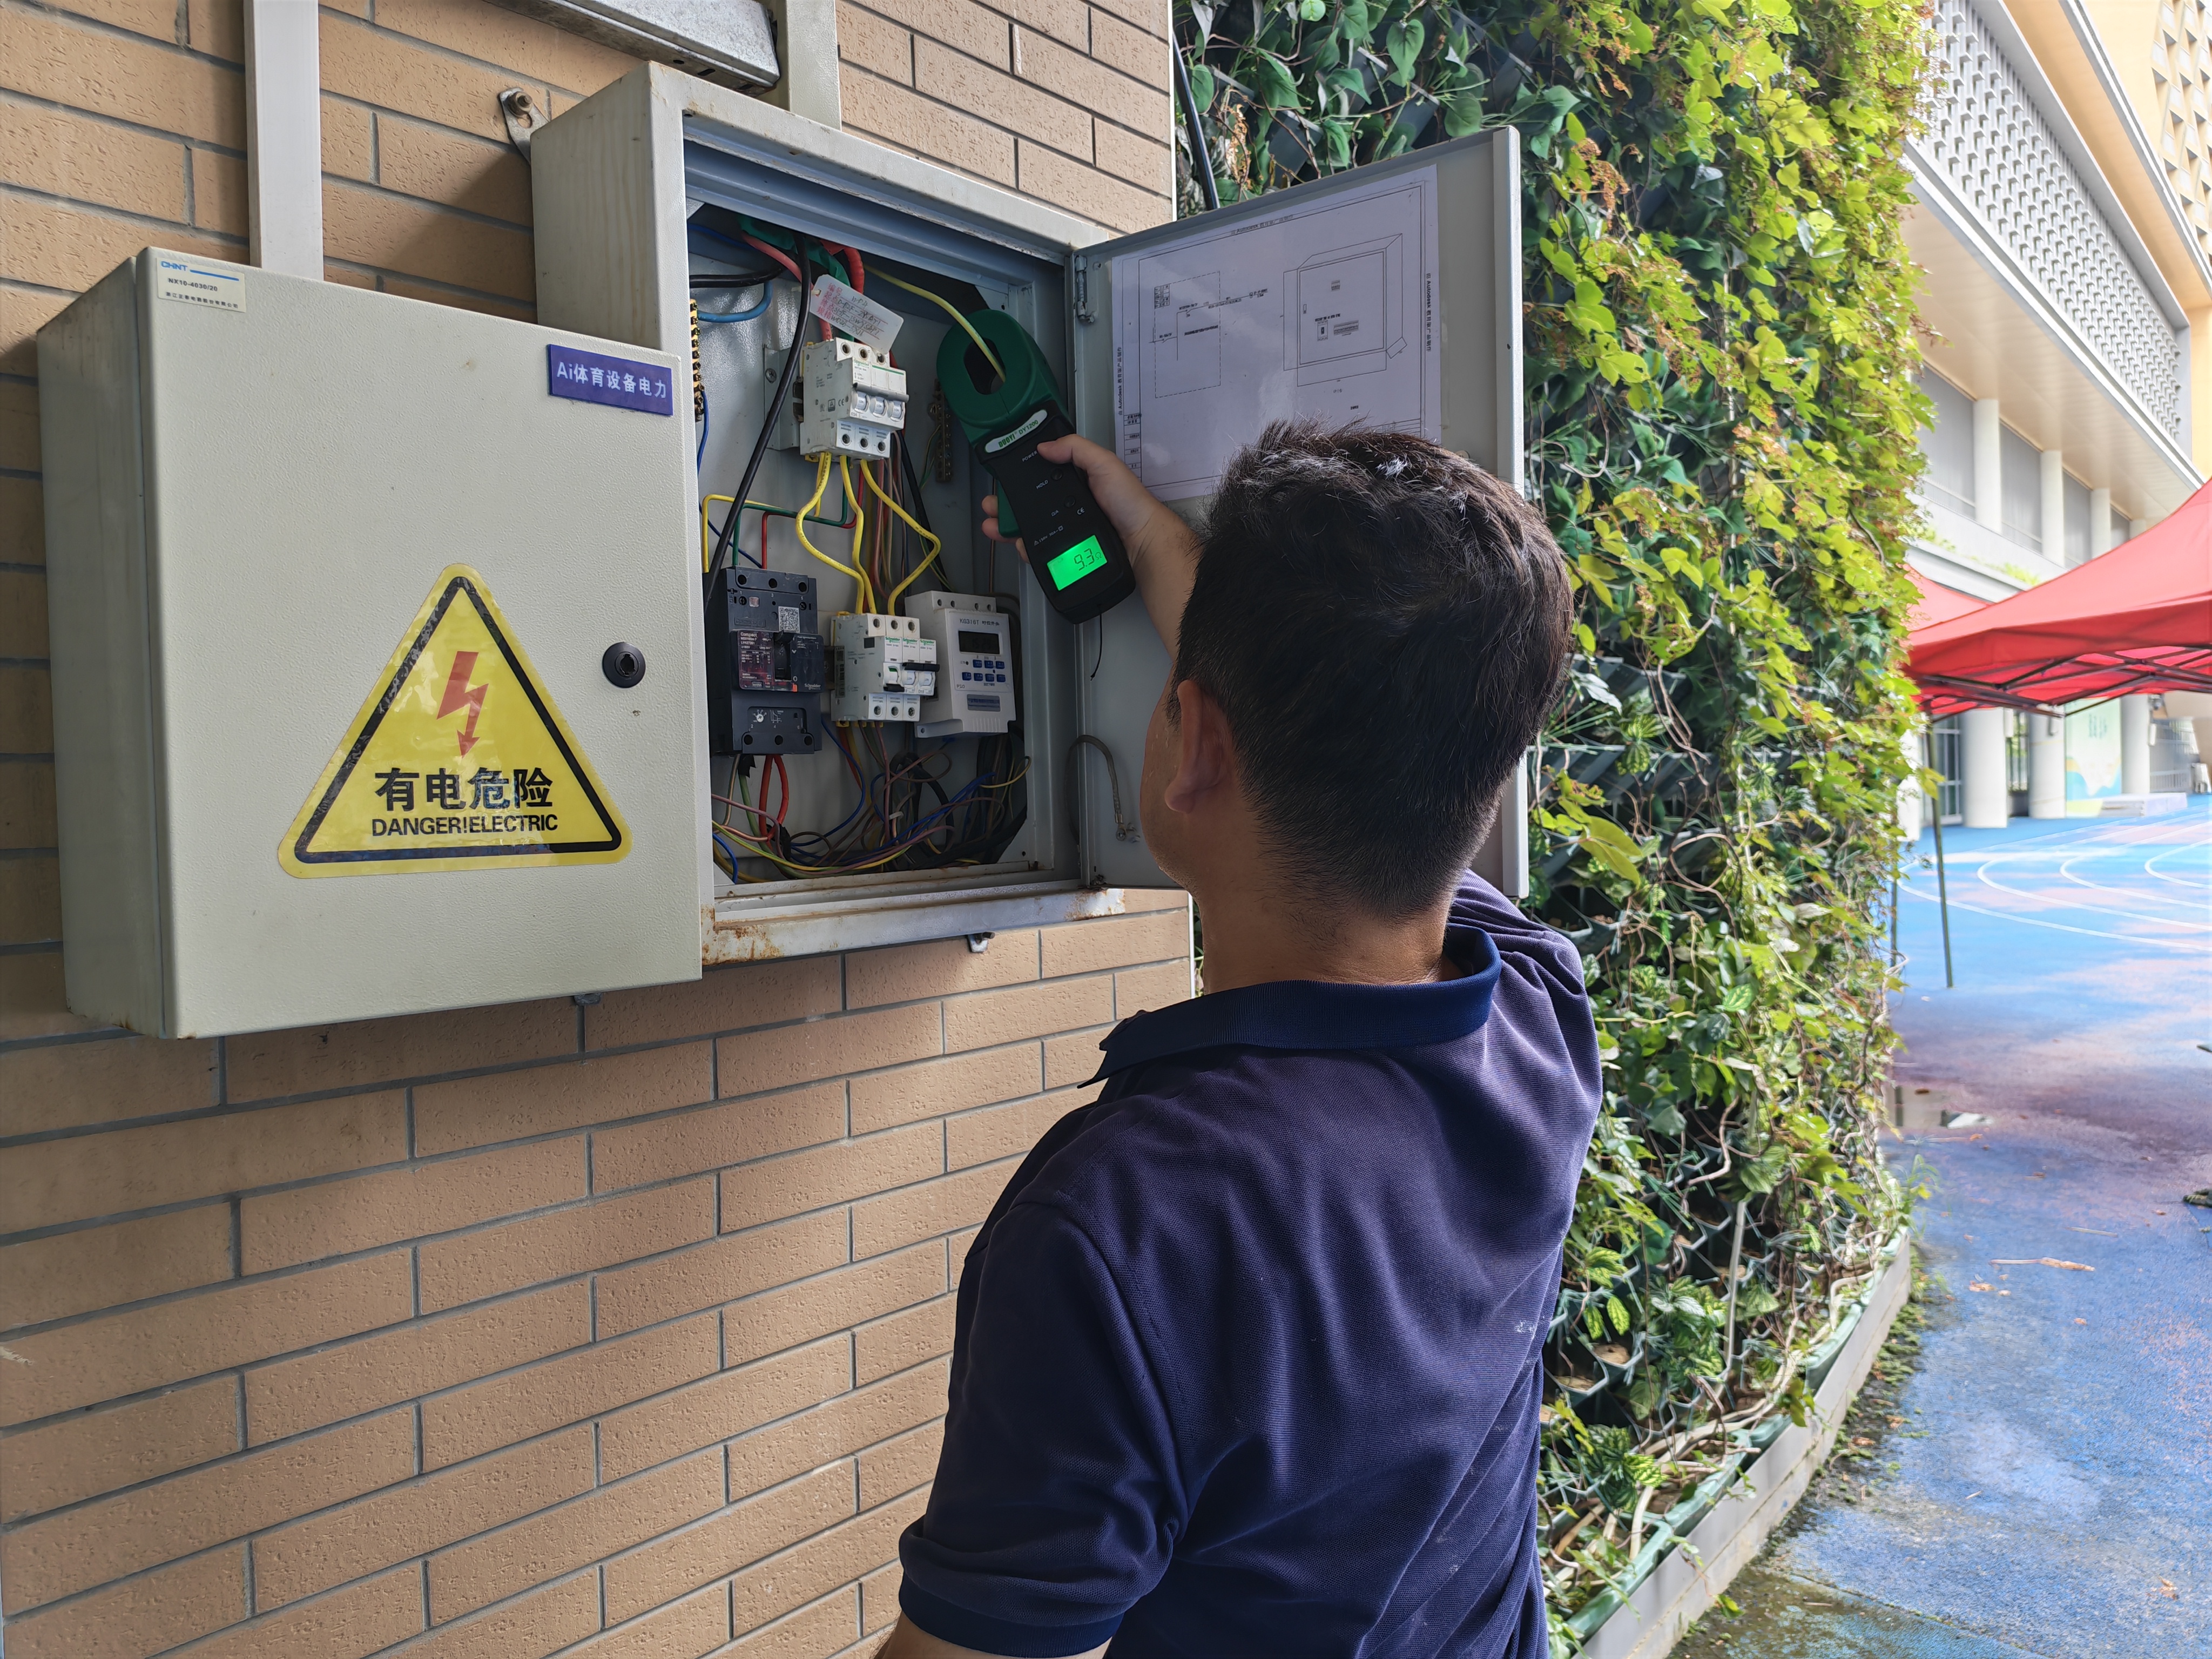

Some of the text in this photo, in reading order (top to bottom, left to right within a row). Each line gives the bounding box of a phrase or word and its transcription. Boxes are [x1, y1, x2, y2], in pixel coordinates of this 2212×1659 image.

[160, 261, 188, 271] CHNT
[167, 278, 218, 292] NX10-4030/20
[557, 361, 666, 399] Ai体育设备电力
[998, 420, 1038, 448] DUOYI DY1200
[1022, 450, 1038, 462] POWER
[1036, 480, 1048, 489] HOLD
[375, 767, 553, 812] 有电危险
[372, 814, 558, 837] DANGER!ELECTRIC
